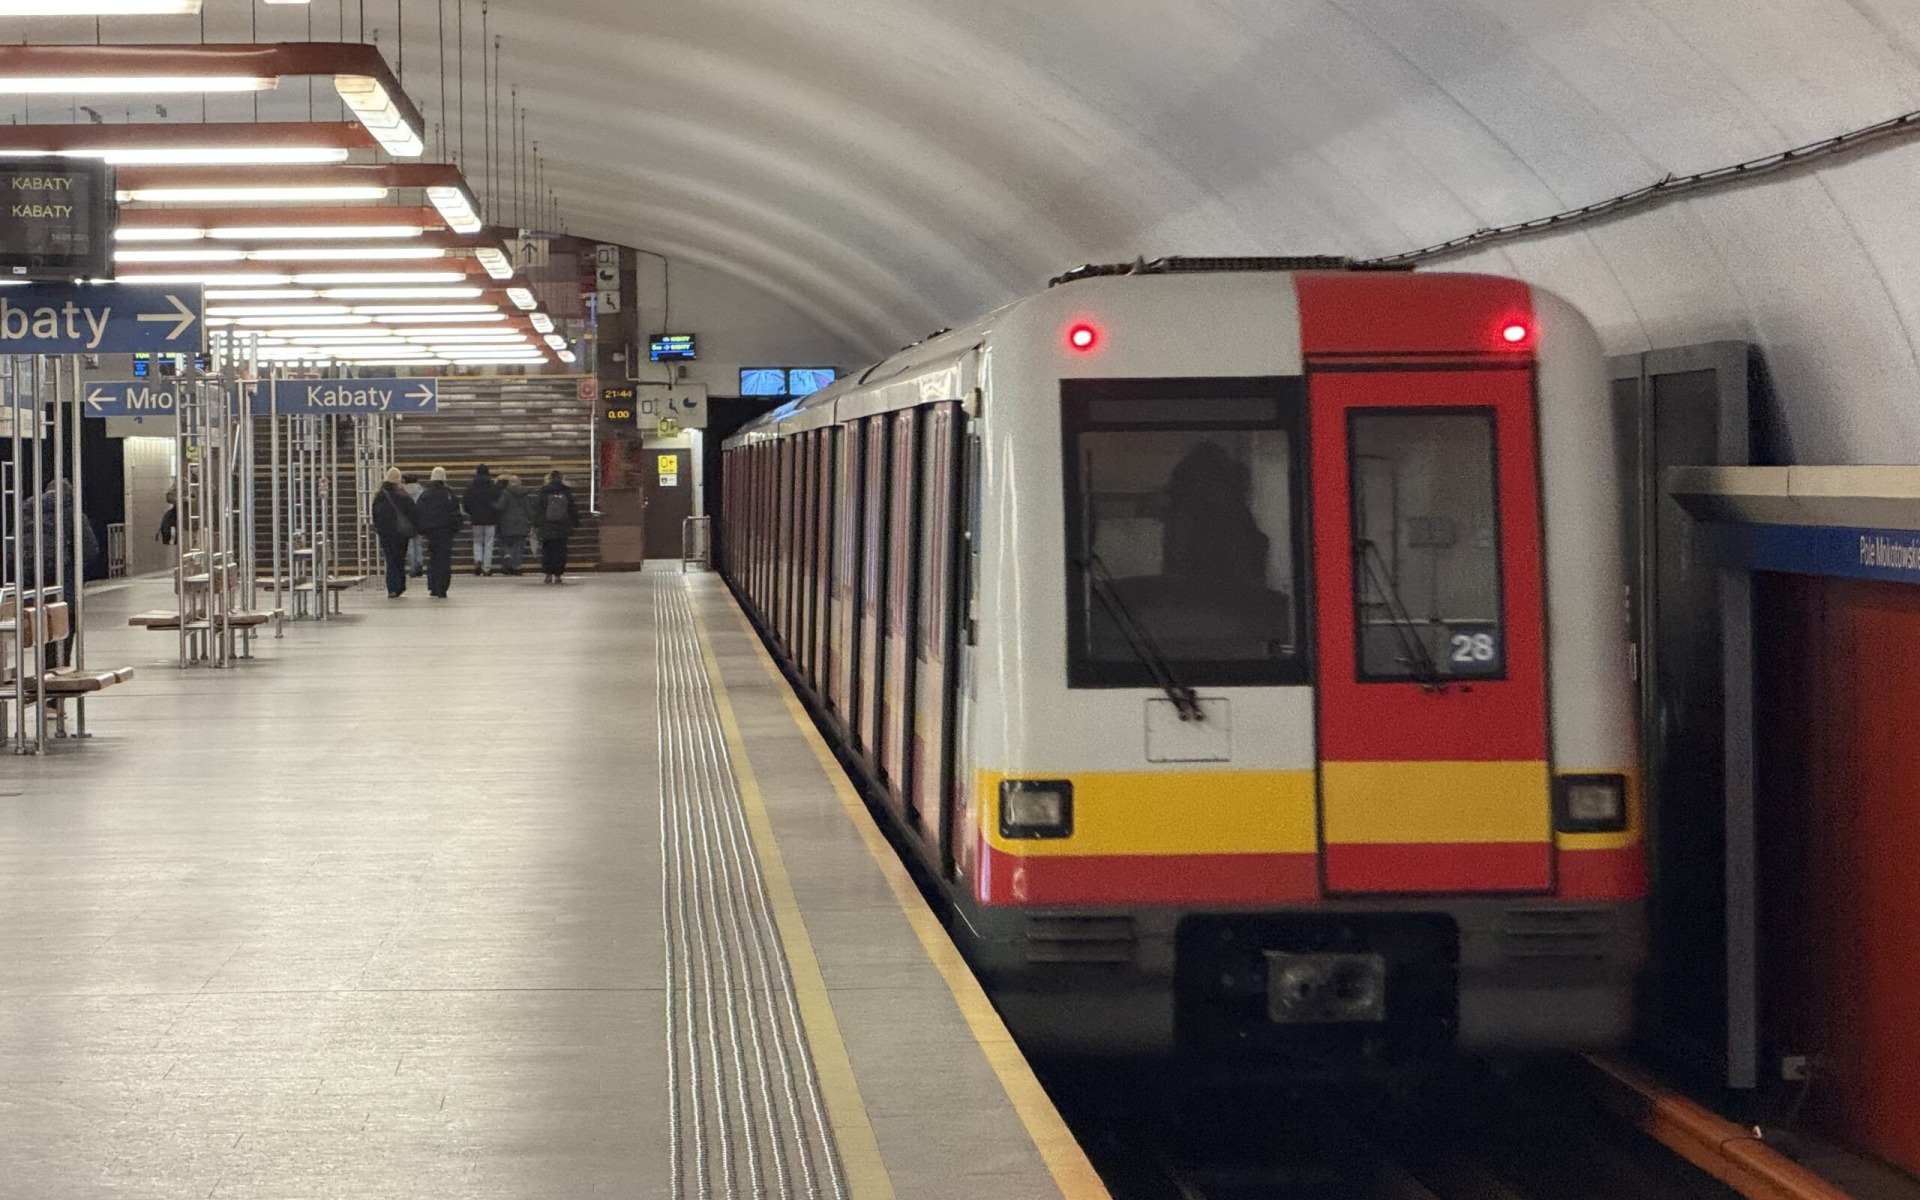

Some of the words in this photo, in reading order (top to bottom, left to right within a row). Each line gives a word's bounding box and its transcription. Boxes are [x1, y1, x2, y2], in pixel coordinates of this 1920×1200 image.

[12, 177, 73, 190] KABATY
[12, 205, 73, 218] KABATY
[0, 298, 111, 349] baty
[307, 385, 393, 411] Kabaty
[604, 390, 632, 399] 21:44
[608, 410, 630, 419] 0.00
[1860, 535, 1875, 567] Pole
[1451, 633, 1494, 662] 28
